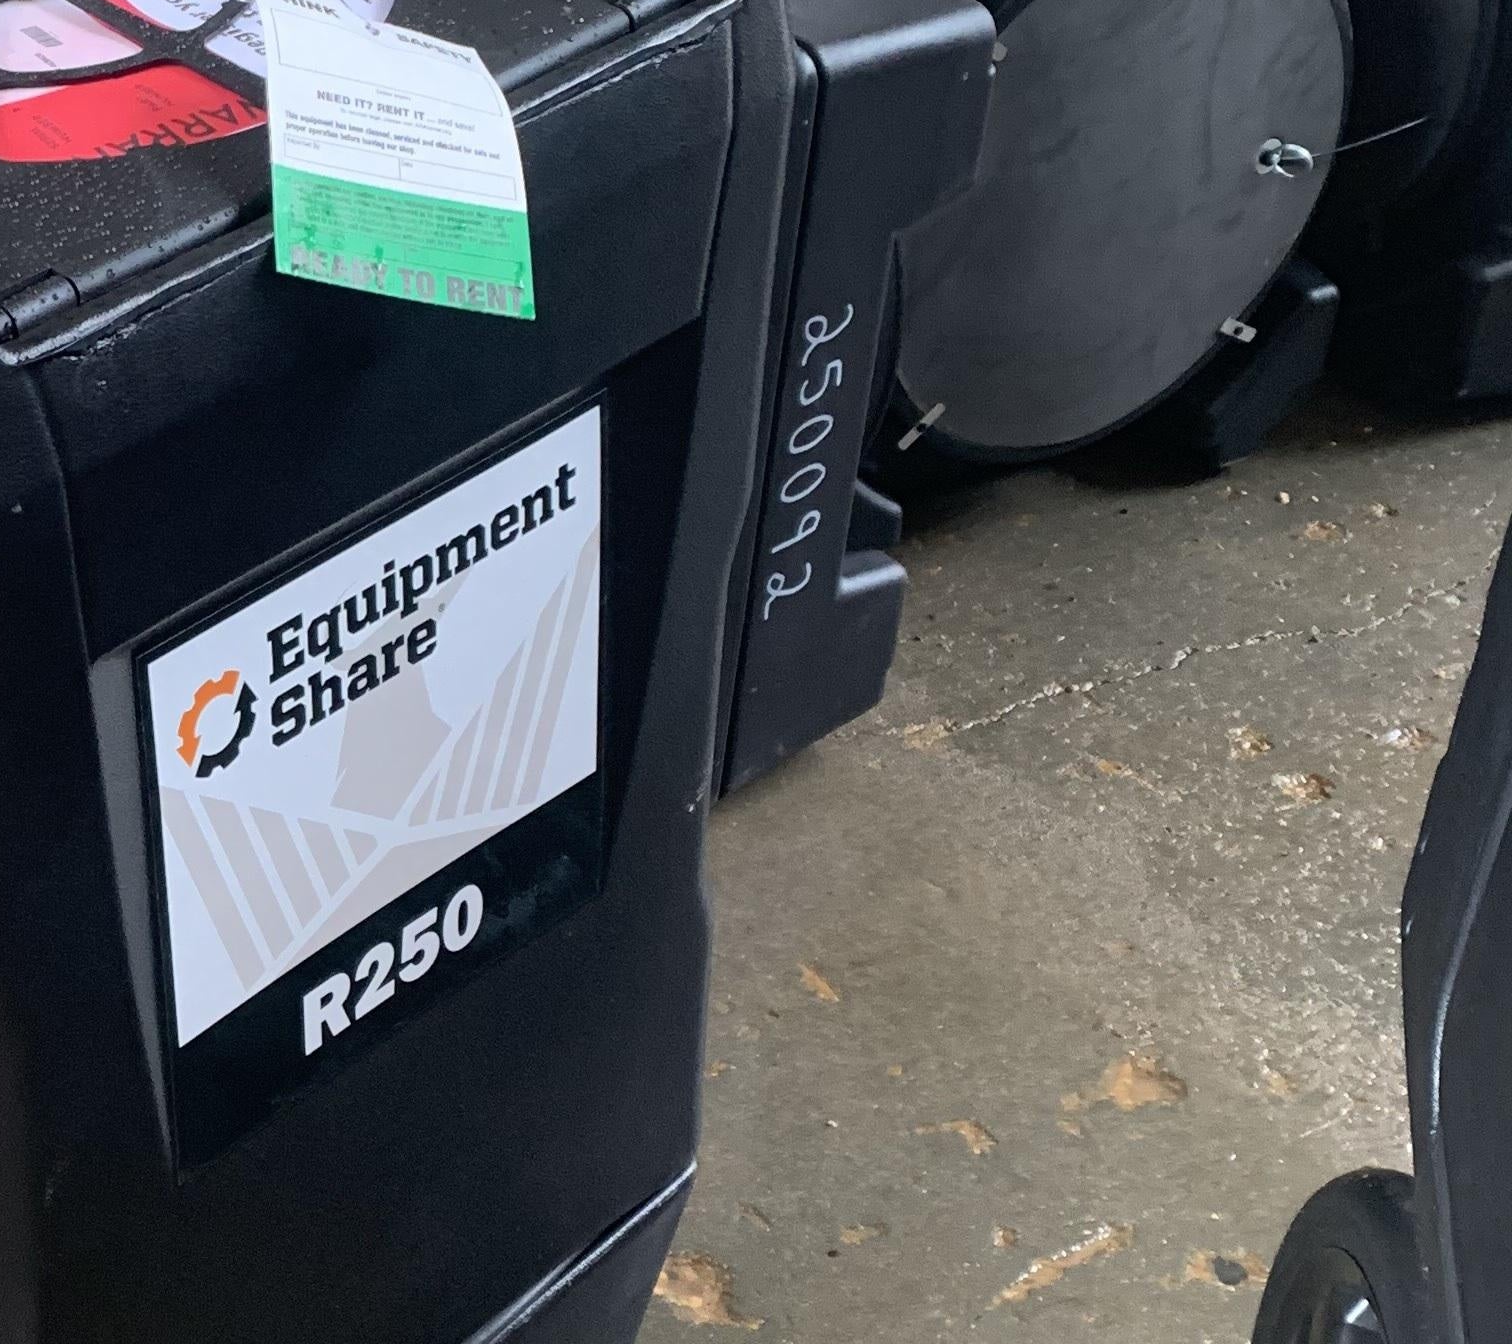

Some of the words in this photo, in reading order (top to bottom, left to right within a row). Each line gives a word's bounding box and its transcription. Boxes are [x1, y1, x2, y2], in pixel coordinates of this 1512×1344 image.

[316, 89, 351, 106] NEED
[355, 98, 374, 110] IT?
[377, 103, 410, 118] RENT
[414, 110, 426, 121] IT
[290, 243, 388, 291] READY
[397, 266, 436, 299] TO
[447, 275, 524, 314] RENT
[762, 303, 855, 622] 250092
[267, 461, 577, 684] Equipment
[271, 615, 438, 748] Share
[303, 883, 484, 1057] R250
